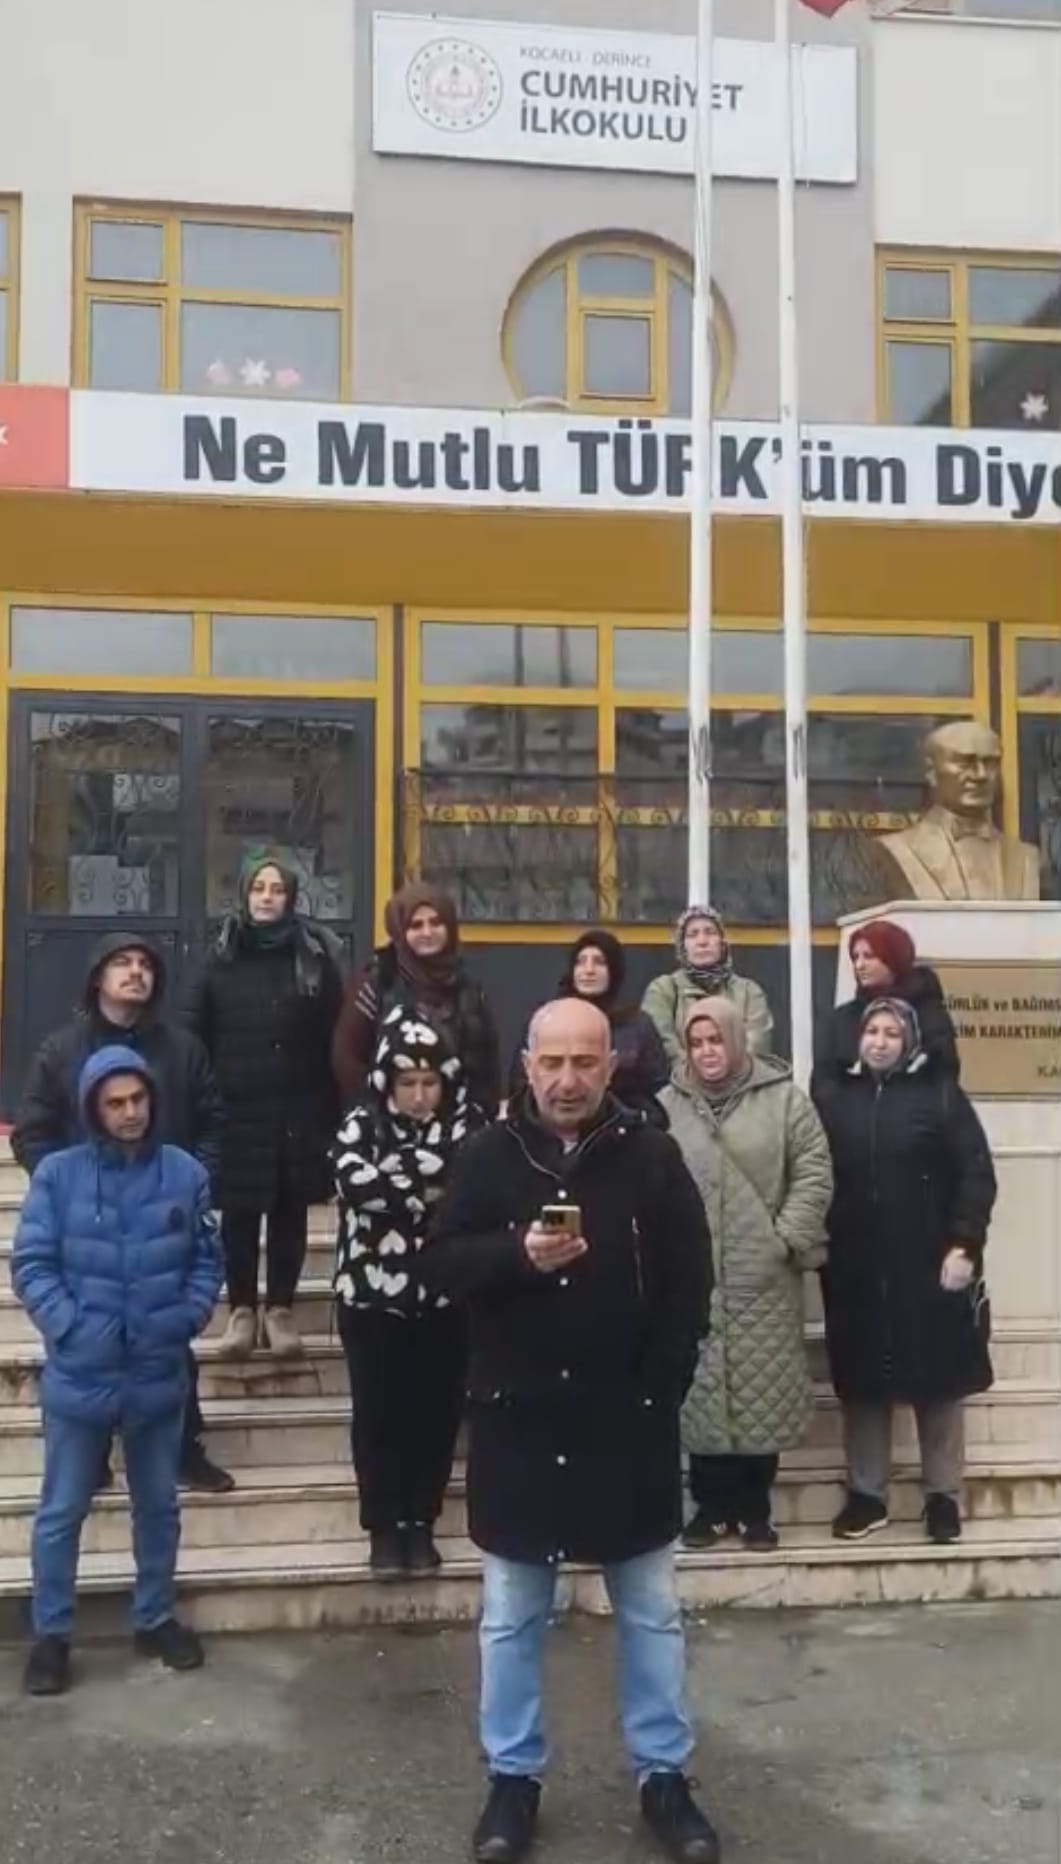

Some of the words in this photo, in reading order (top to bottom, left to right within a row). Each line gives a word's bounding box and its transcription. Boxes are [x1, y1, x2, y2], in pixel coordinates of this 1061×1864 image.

[520, 70, 743, 110] CUMHURİYET
[520, 99, 687, 142] İLKOKULU
[183, 415, 287, 483] Ne
[317, 421, 540, 492] Mutlu
[936, 444, 1061, 519] Diy
[993, 1001, 1009, 1011] ve
